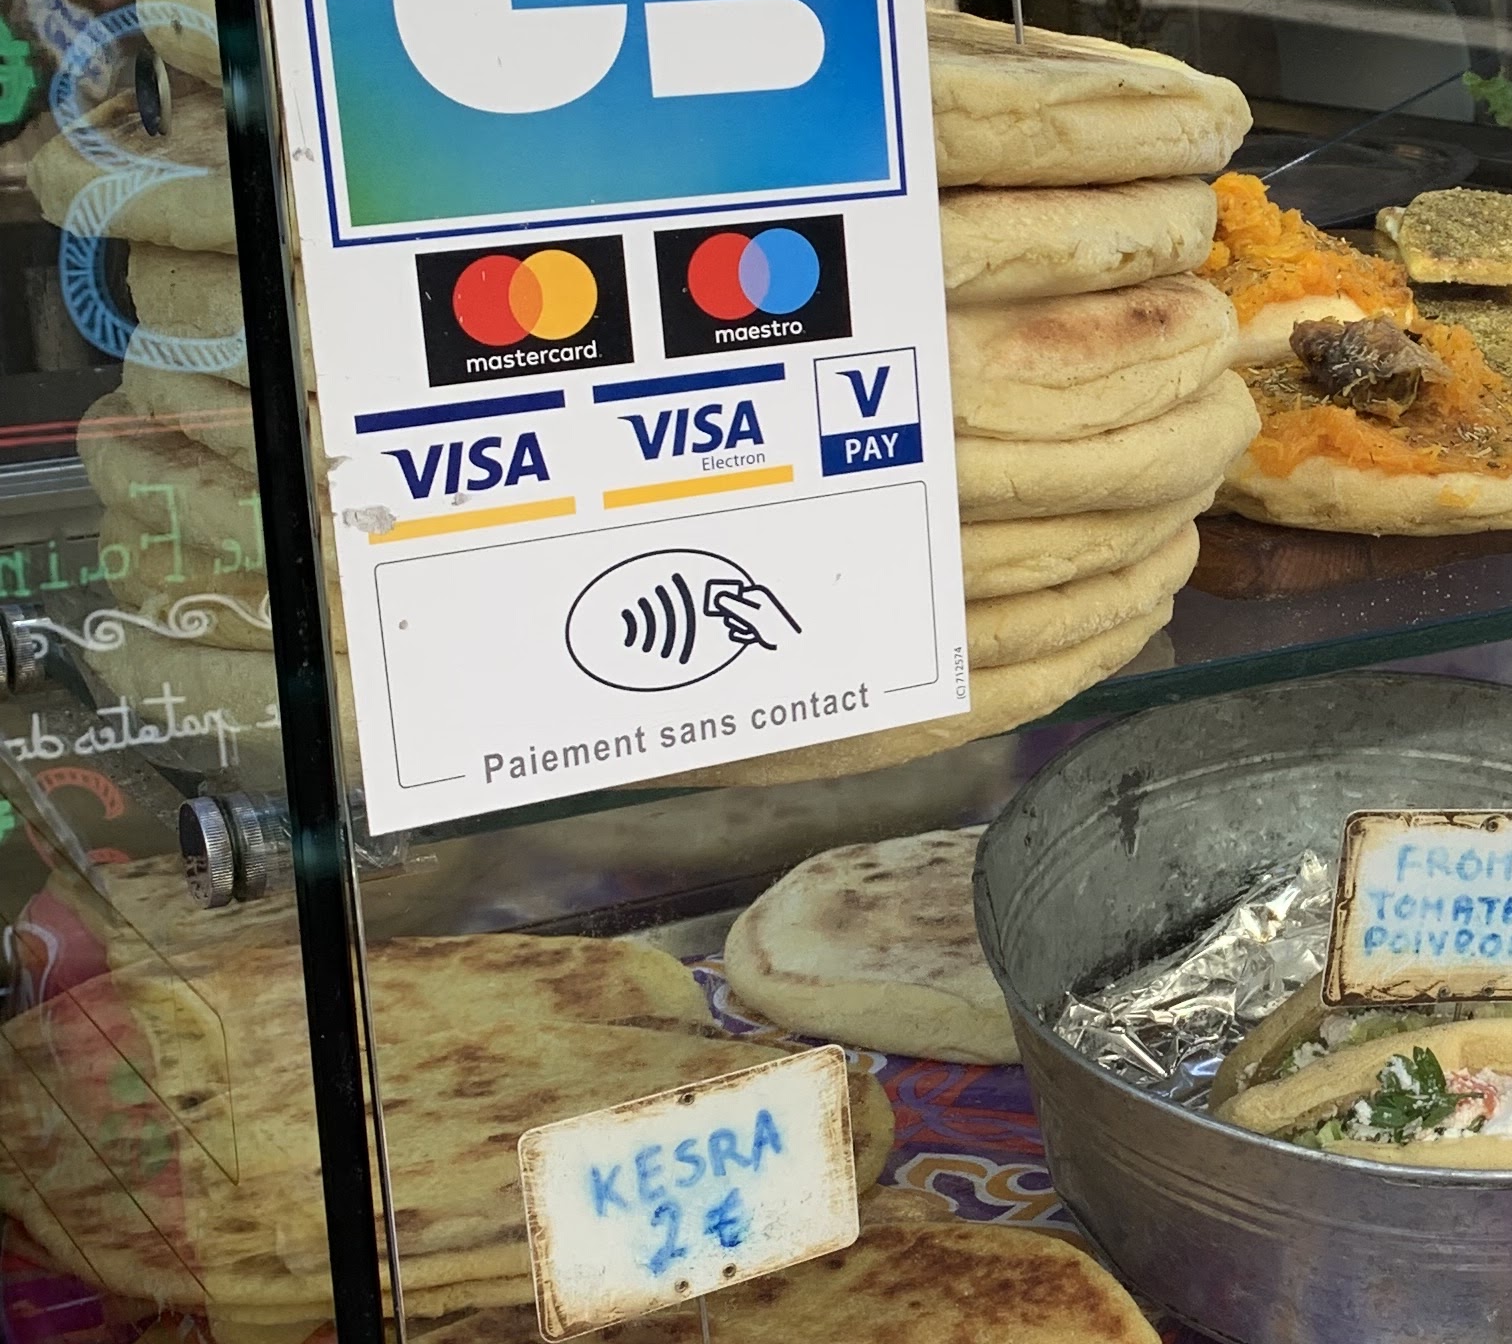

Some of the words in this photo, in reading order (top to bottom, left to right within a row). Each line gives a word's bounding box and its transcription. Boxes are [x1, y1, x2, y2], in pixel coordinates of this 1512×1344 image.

[465, 339, 598, 375] mastercard
[713, 317, 804, 345] maestro
[380, 431, 551, 500] VISA
[617, 399, 765, 462] VISA
[835, 365, 891, 418] V
[701, 450, 766, 473] Electron
[844, 431, 900, 465] PAY
[482, 725, 648, 785] Paiement
[659, 712, 737, 750] sans
[750, 682, 871, 730] contact
[588, 1108, 783, 1218] KESRA
